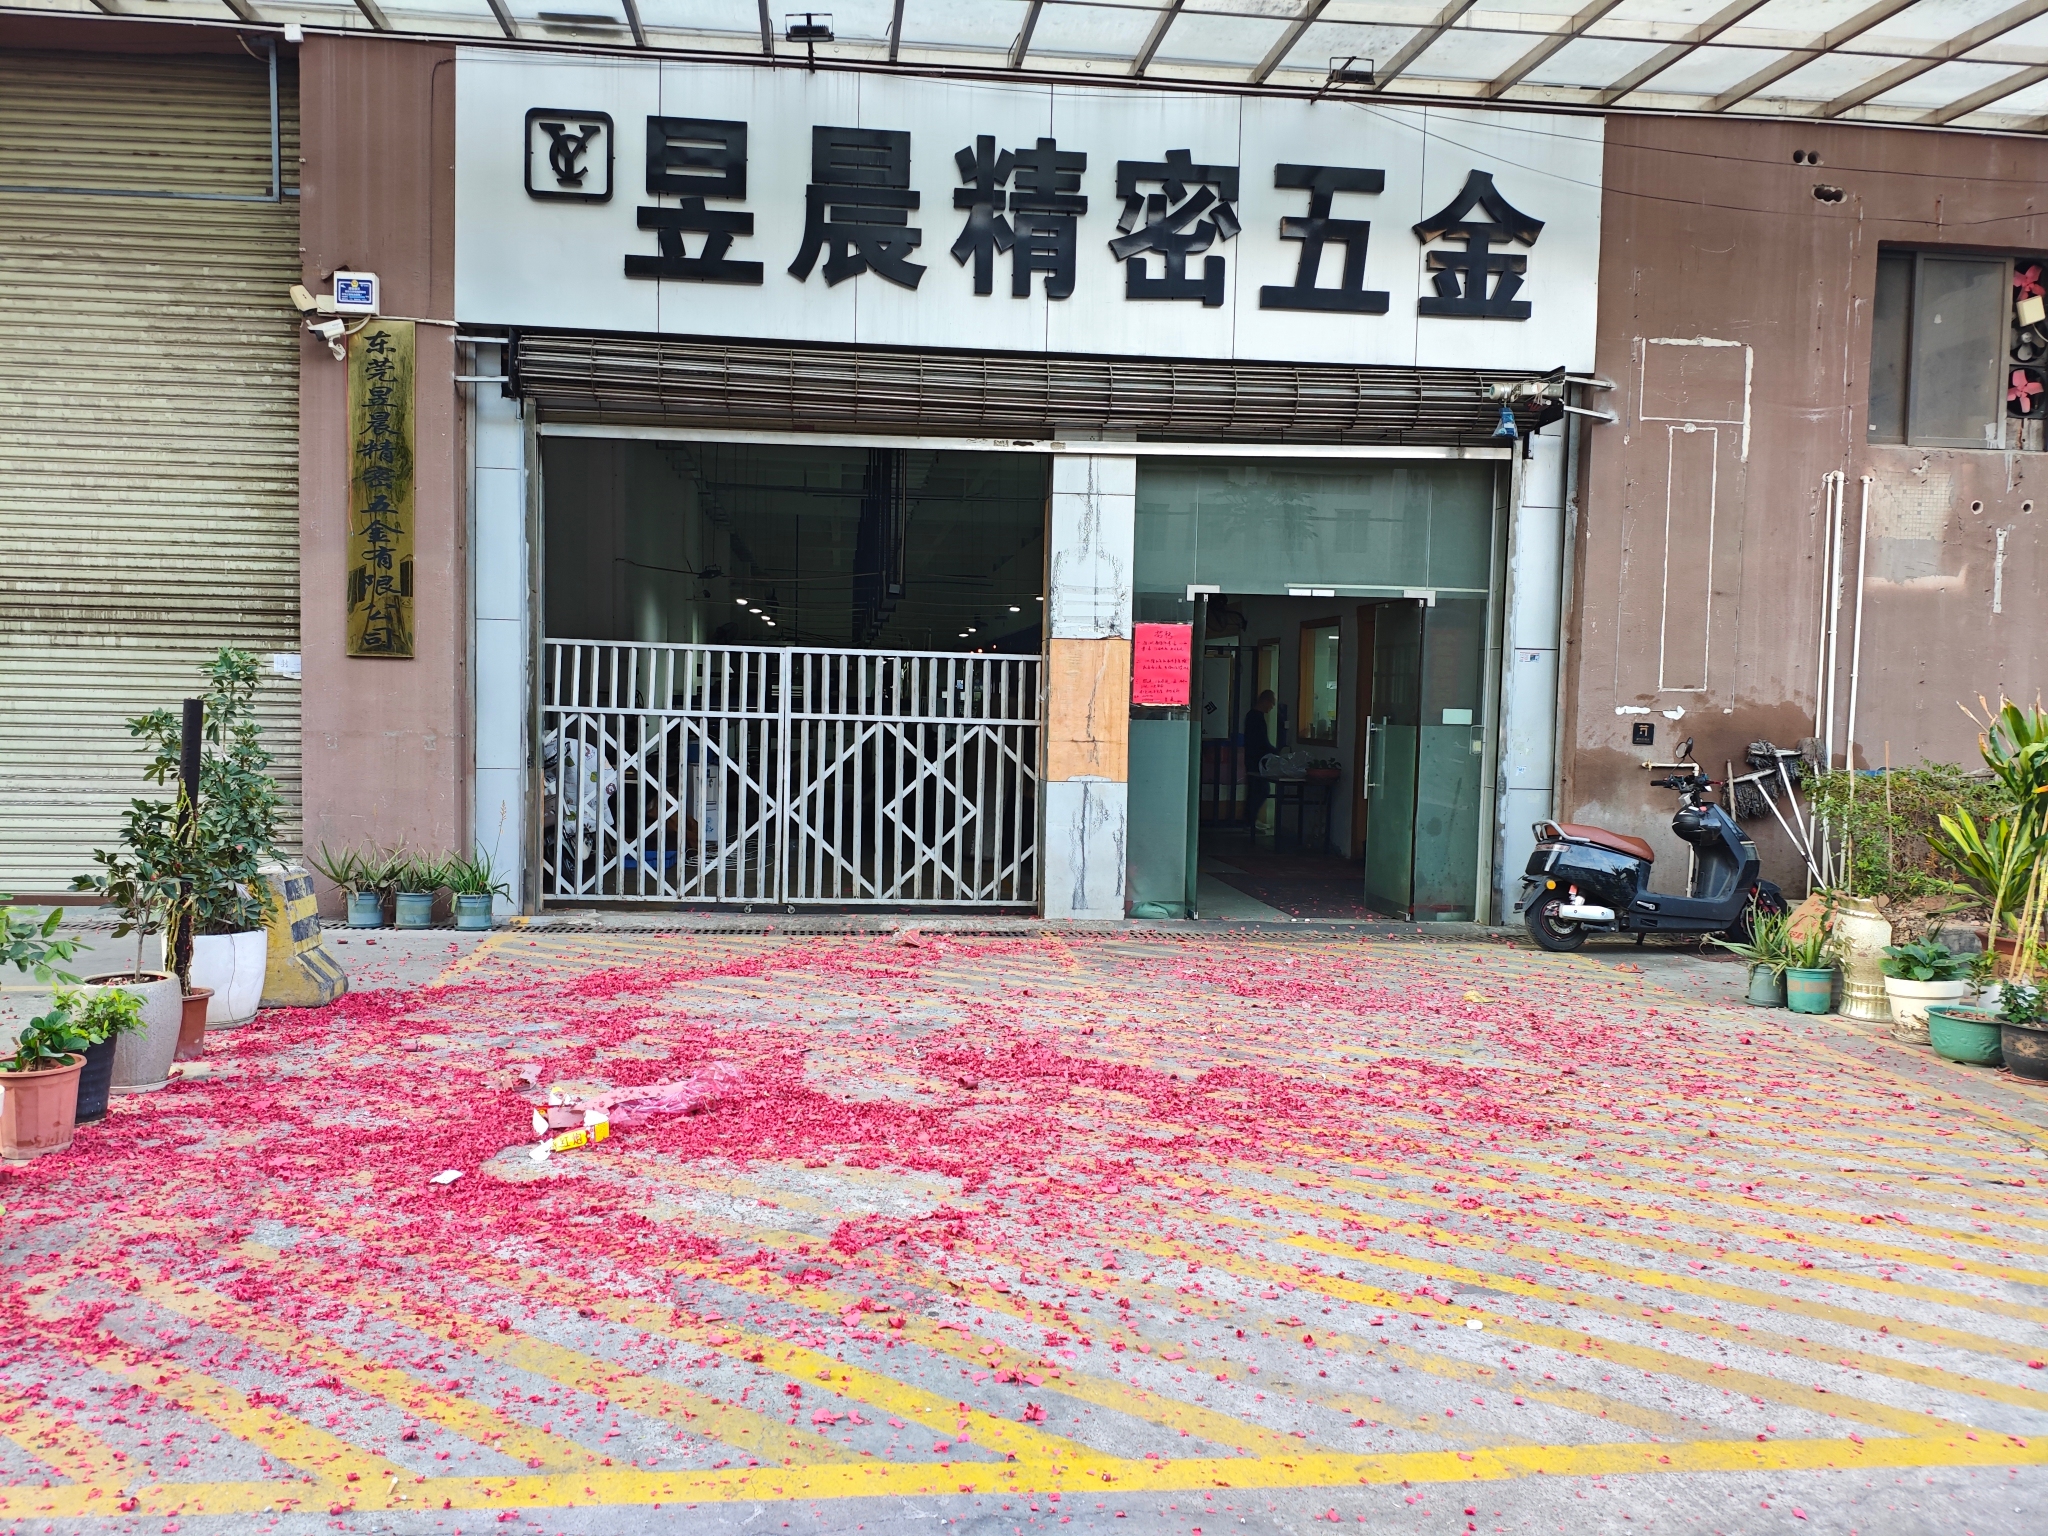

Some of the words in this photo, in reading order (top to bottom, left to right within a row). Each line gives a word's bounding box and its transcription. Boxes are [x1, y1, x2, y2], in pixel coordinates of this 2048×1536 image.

[624, 114, 1546, 320] 昱晨精密五金
[356, 330, 405, 650] 东莞昱晨精密五金有限公司
